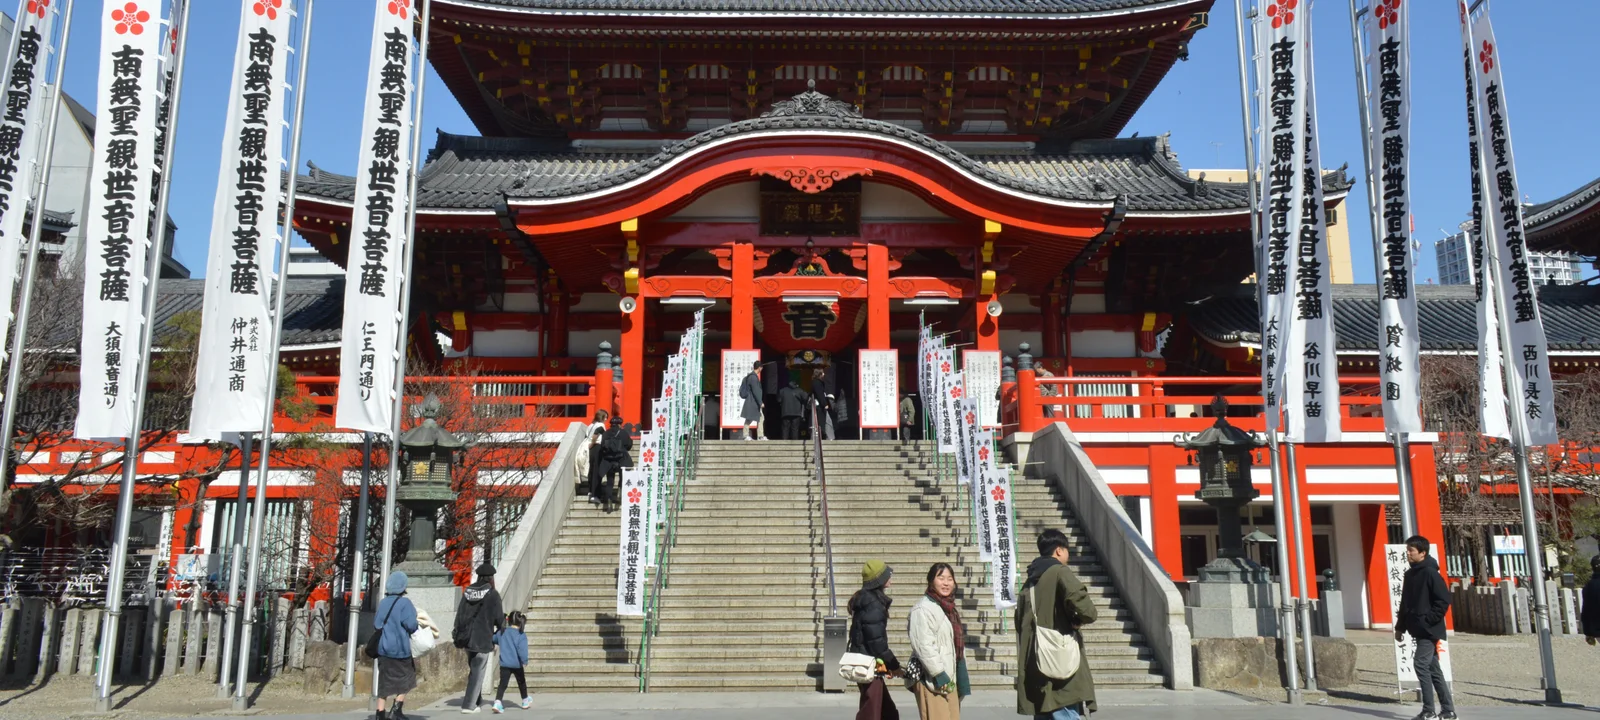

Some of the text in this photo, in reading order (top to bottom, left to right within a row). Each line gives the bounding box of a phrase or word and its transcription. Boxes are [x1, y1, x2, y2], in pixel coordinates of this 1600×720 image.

[100, 45, 144, 302] 南無聖観世音菩薩
[230, 27, 276, 295] 南無聖観世音菩薩
[359, 27, 408, 297] 南無聖観世音菩薩
[104, 321, 122, 410] 大須観音通り
[228, 318, 247, 393] 仲井通商
[249, 317, 258, 352] 株式会社
[360, 321, 377, 402] 仁王門通り
[782, 301, 838, 340] 音
[624, 503, 641, 606] 南無聖観世音菩薩
[994, 501, 1011, 601] 南無聖観世音菩薩
